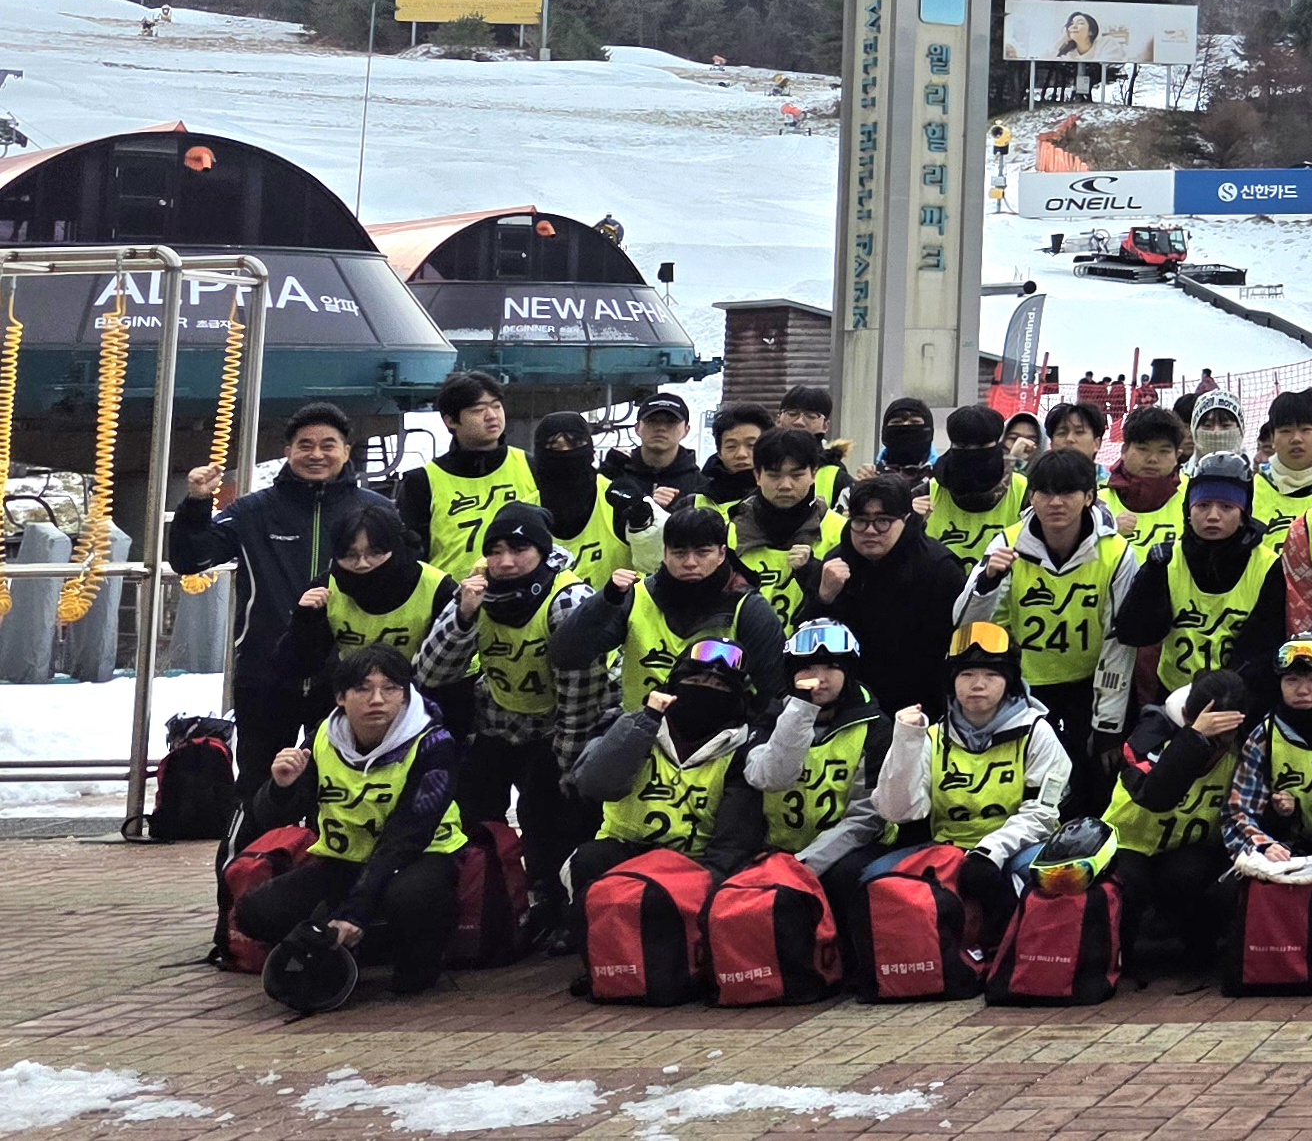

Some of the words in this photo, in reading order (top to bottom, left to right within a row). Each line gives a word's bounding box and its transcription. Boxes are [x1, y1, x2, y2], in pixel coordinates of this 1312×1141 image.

[857, 122, 878, 221] HILLI
[1045, 196, 1143, 212] O'NEILL
[1240, 184, 1299, 200] 신한카드
[852, 233, 874, 330] PARK
[319, 295, 360, 316] 알파
[504, 297, 585, 320] NEW
[593, 299, 674, 325] ALPHA
[502, 324, 556, 334] BEGINNER
[1021, 616, 1089, 653] 241
[783, 790, 842, 830] 32
